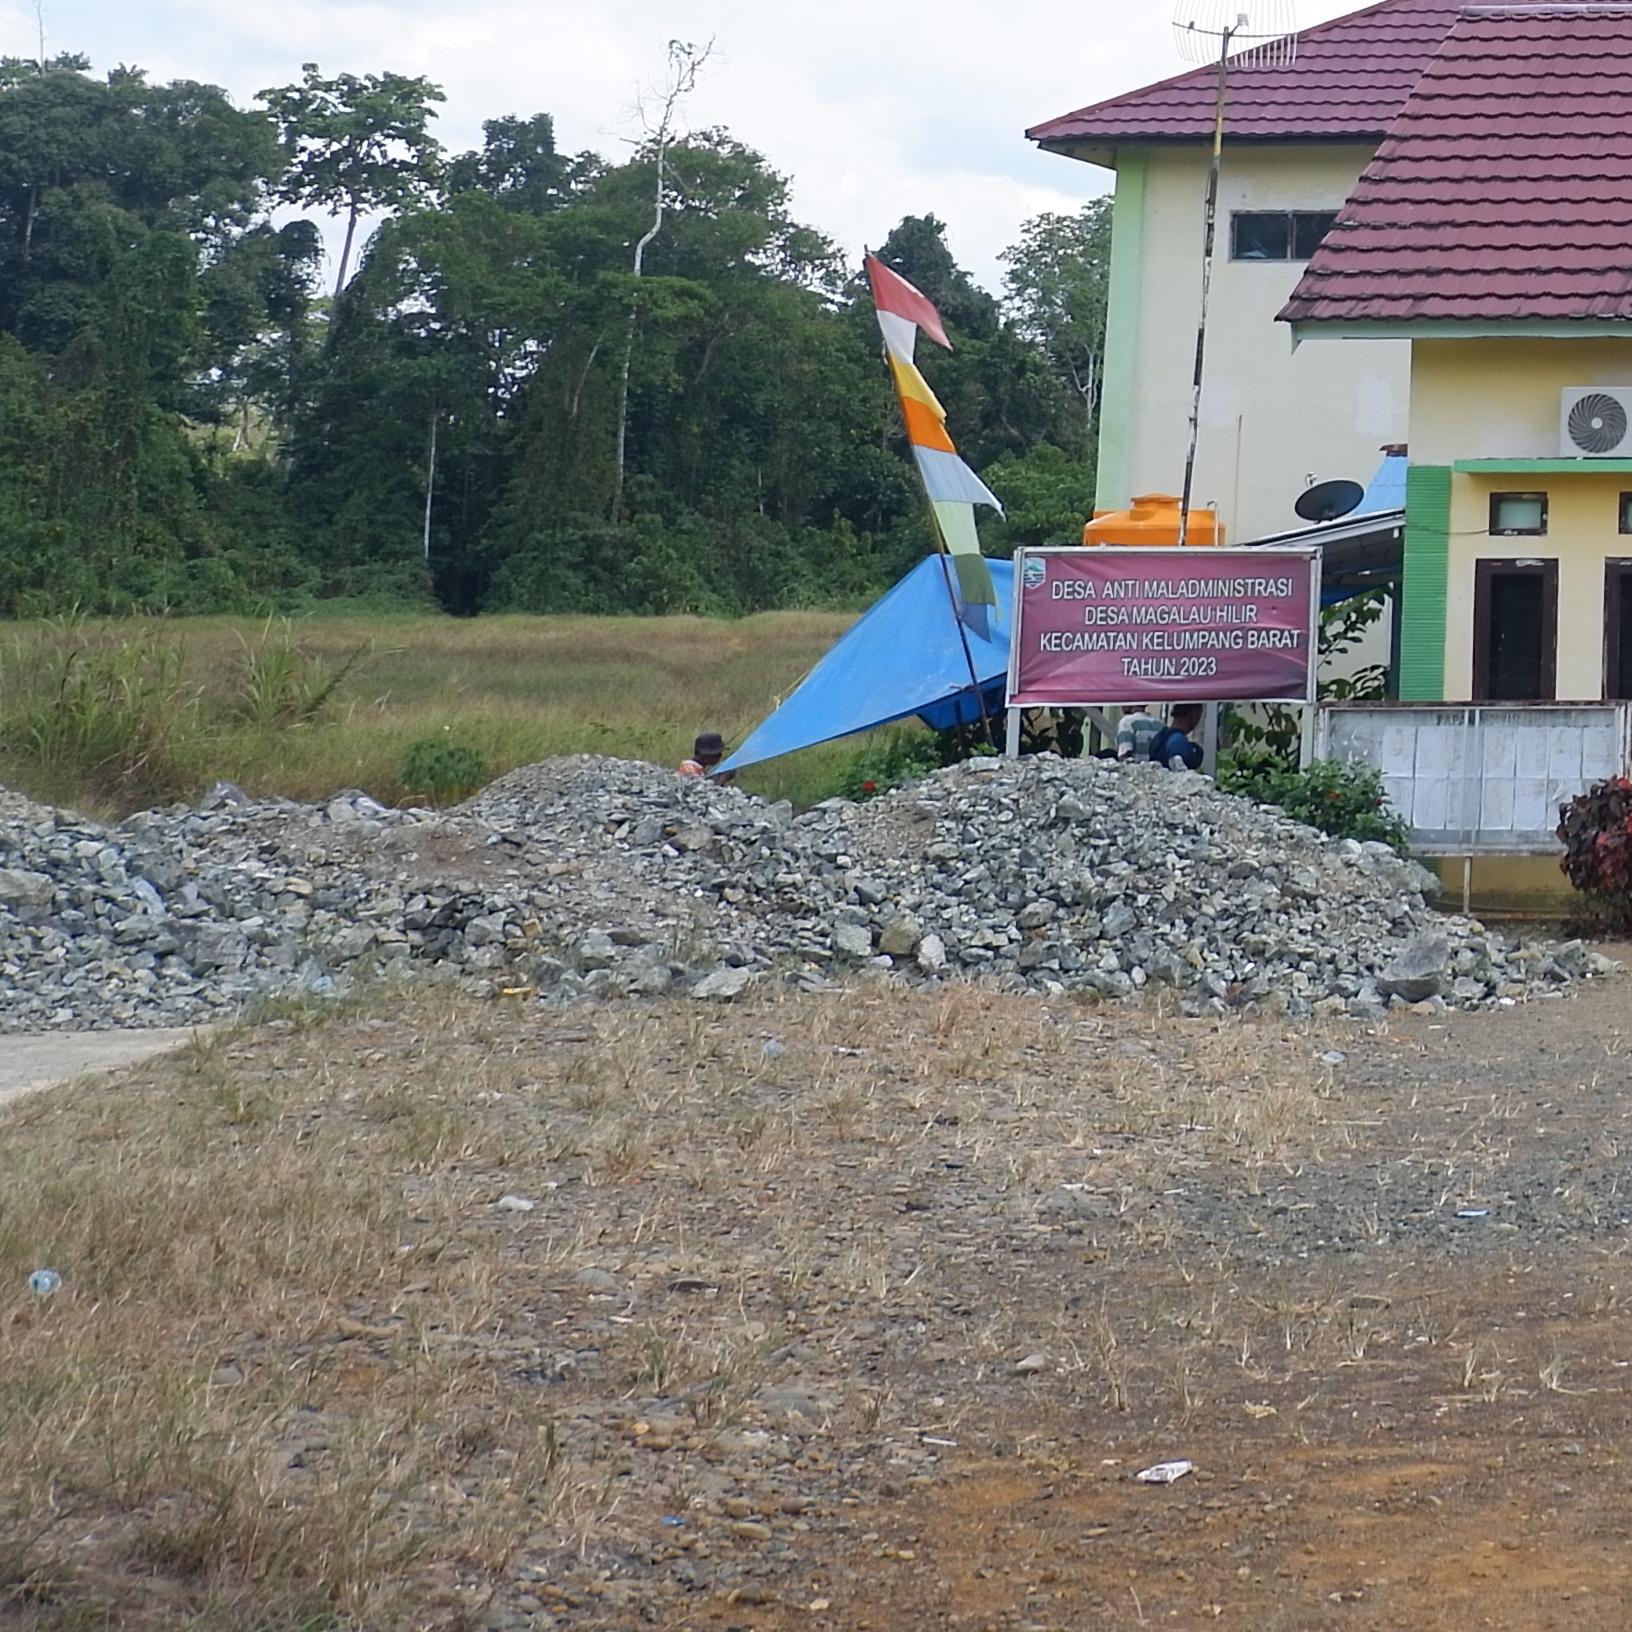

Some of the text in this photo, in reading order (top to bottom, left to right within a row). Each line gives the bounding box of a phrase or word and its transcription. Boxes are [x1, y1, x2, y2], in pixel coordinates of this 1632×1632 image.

[1051, 578, 1293, 600] DESA ANTI MALADMINISTRASI
[1084, 605, 1257, 625] DESA MAGALAU HILIR
[1040, 629, 1300, 651] KECAMATAN KELUMPANG BARAT
[1121, 657, 1217, 676] TAHUN 2023
